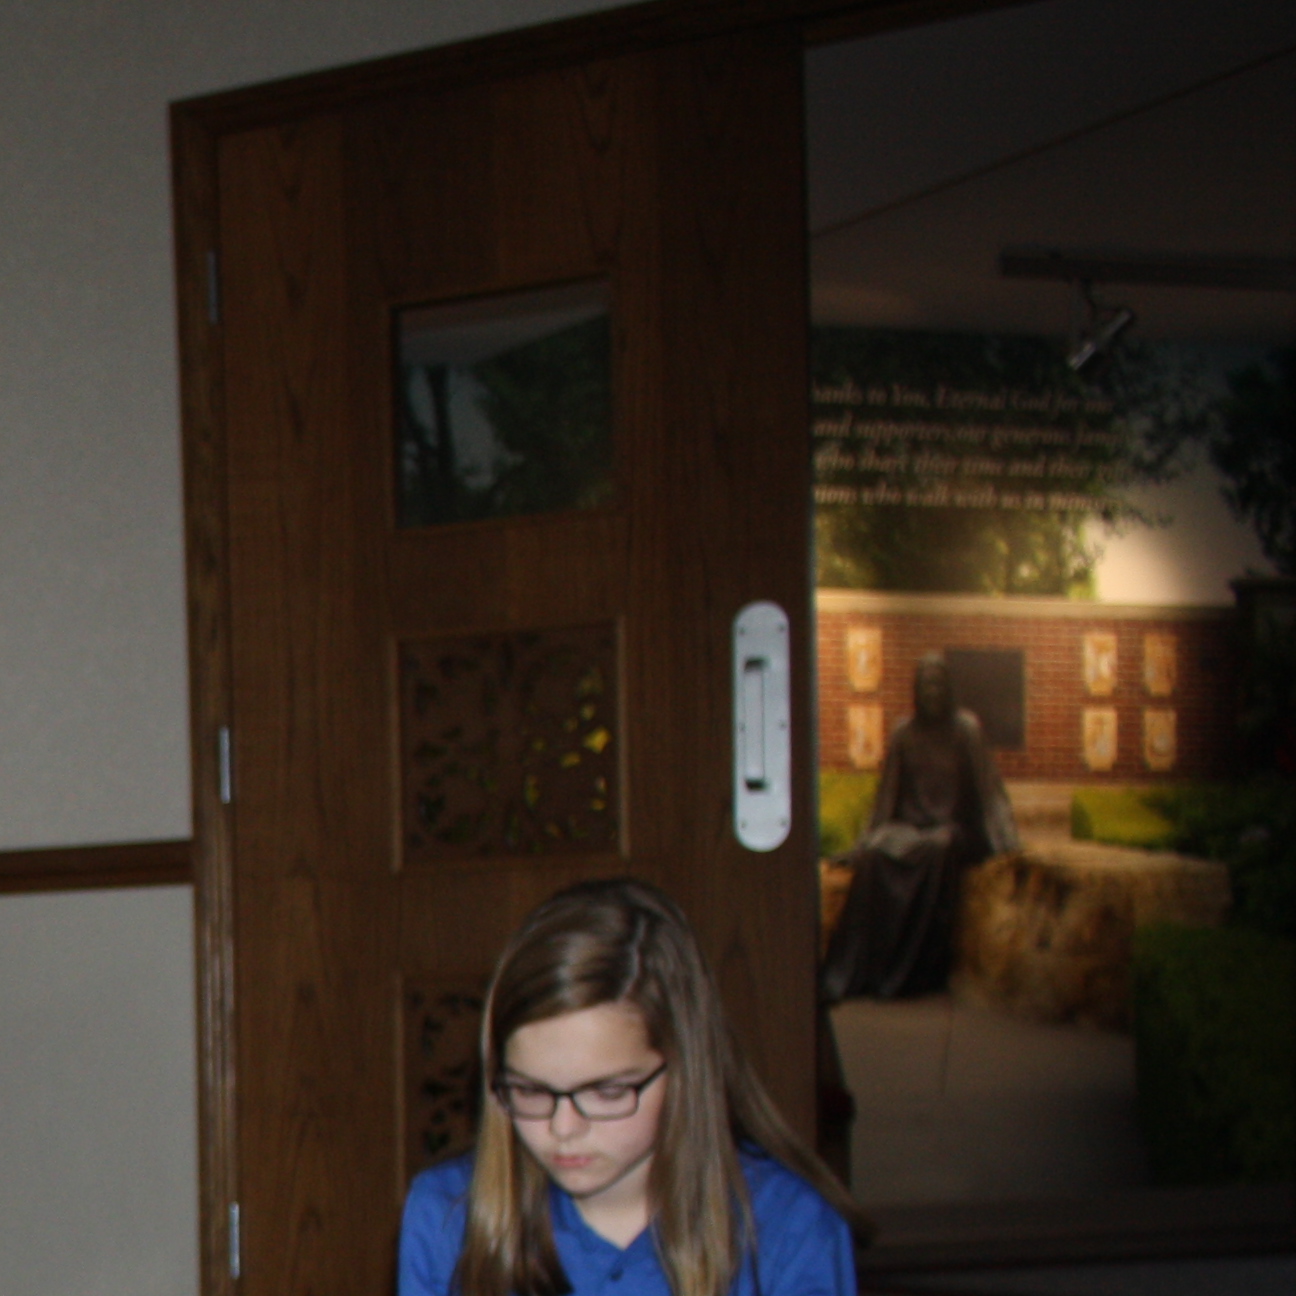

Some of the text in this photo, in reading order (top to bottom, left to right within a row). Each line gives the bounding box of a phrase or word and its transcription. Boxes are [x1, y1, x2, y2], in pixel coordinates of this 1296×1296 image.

[812, 376, 862, 404] hanks
[866, 387, 886, 405] to
[1009, 453, 1047, 477] and
[862, 480, 902, 506] who
[954, 483, 998, 508] with
